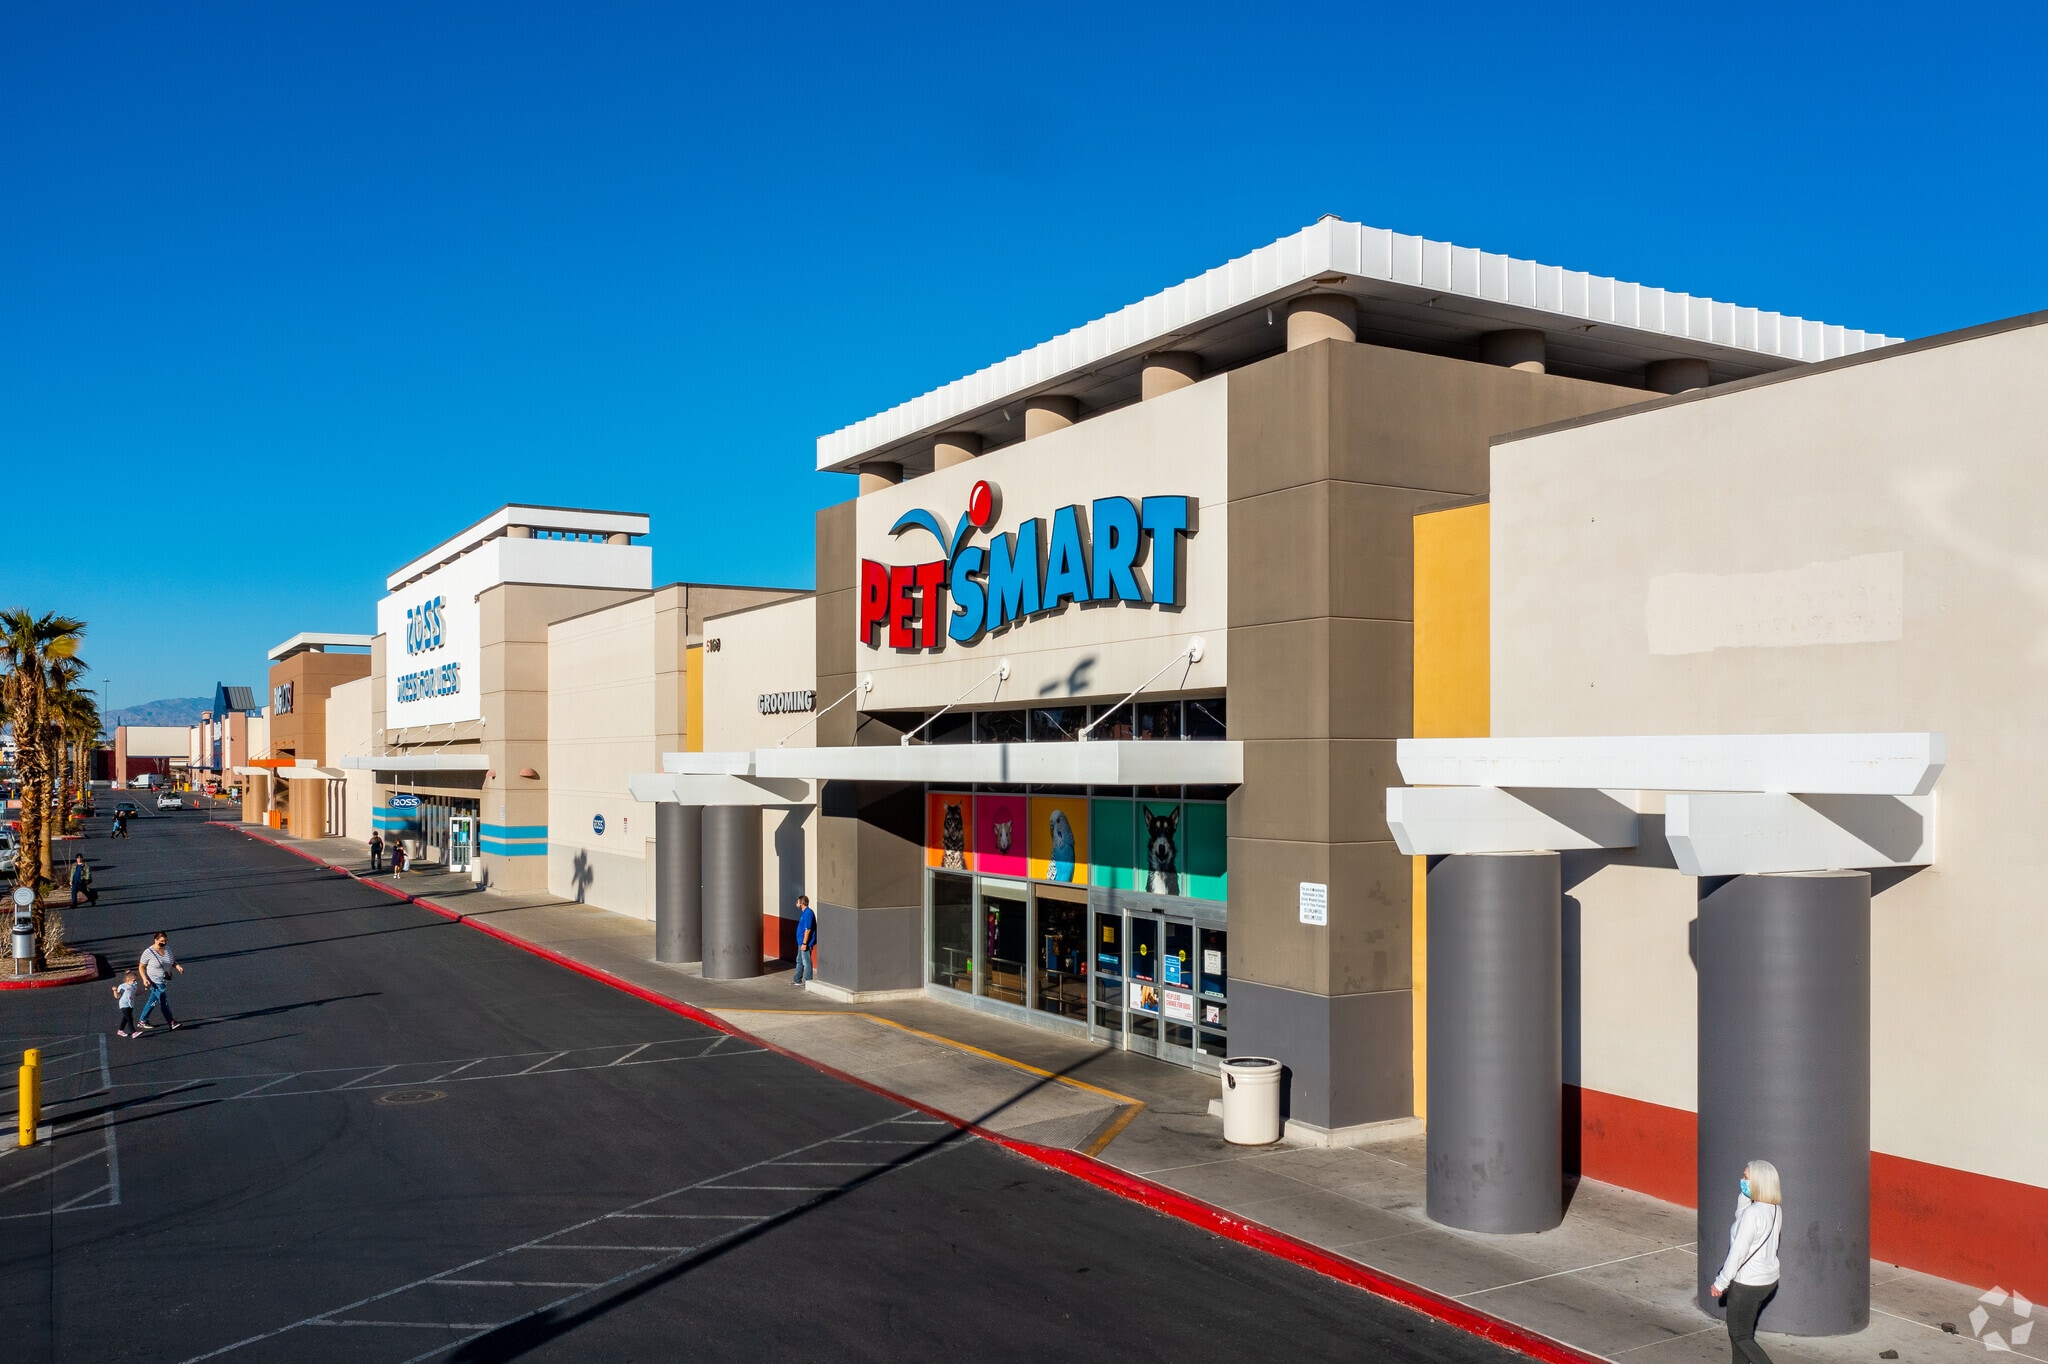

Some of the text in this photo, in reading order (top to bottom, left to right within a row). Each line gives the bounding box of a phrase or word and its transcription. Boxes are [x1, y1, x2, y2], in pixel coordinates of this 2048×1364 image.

[860, 495, 1192, 649] PETSMART
[407, 595, 445, 655] ROSS
[397, 662, 459, 702] DRESS FOR LESS
[757, 690, 815, 714] GROOMING
